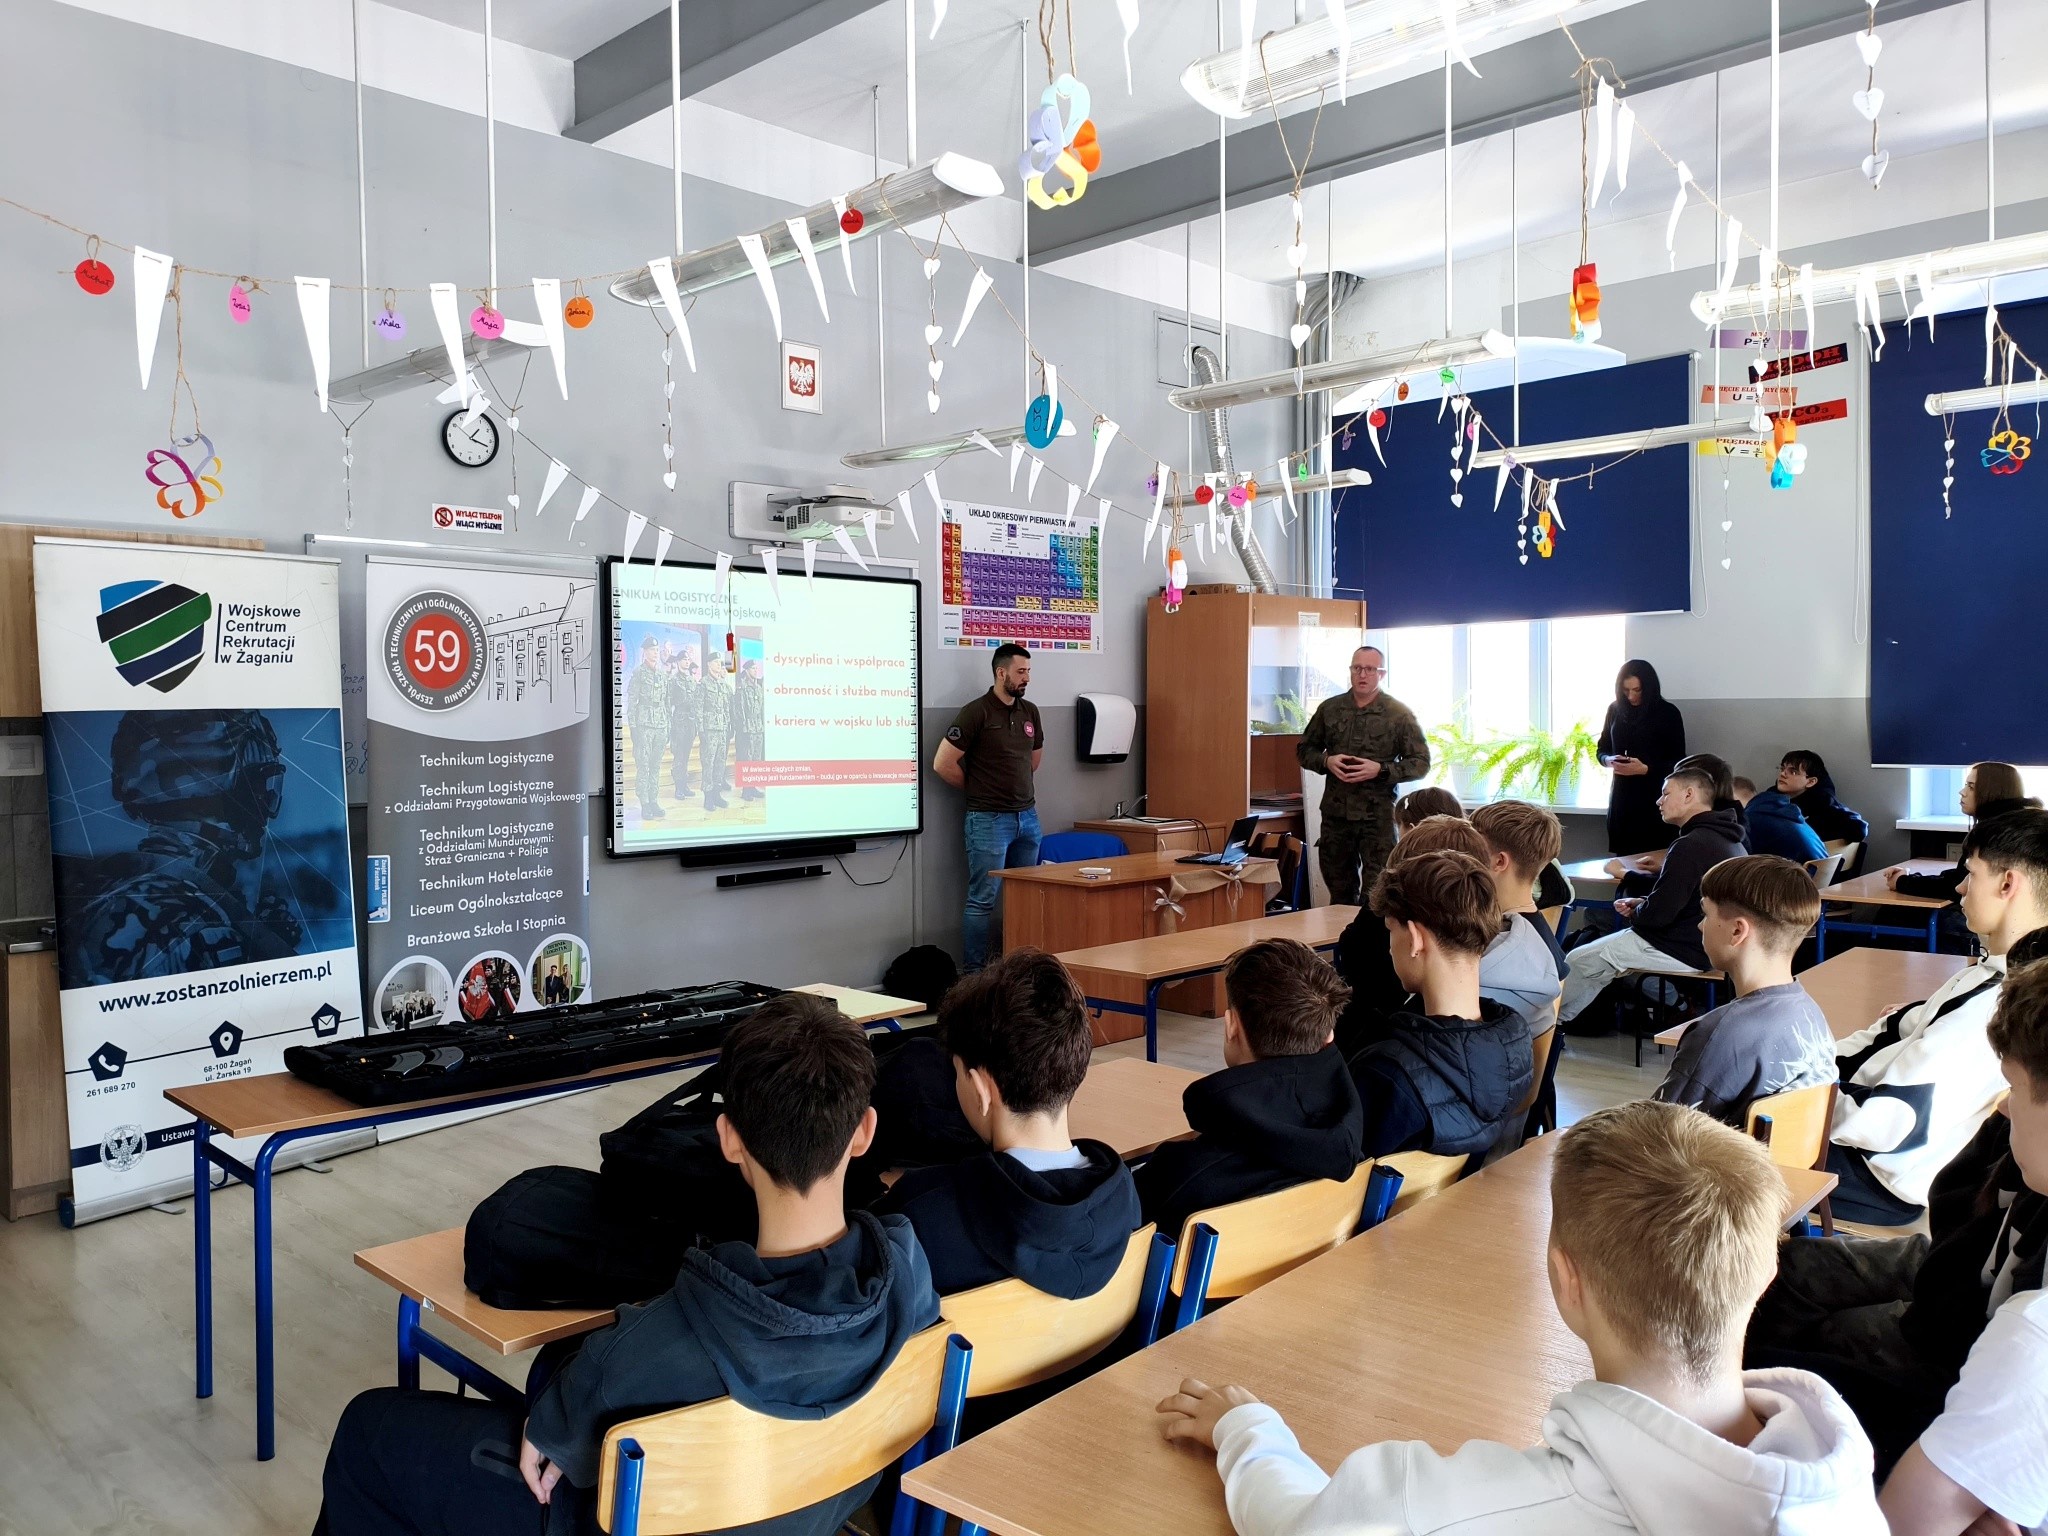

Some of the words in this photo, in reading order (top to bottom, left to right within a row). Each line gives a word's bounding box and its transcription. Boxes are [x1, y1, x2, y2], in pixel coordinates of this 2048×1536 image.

[476, 521, 502, 530] MYŚLENIE
[969, 509, 990, 518] UKŁAD
[992, 513, 1028, 522] OKRESOWY
[1030, 516, 1076, 528] PIERWIASTKW
[621, 589, 661, 600] NIKUM
[664, 592, 738, 604] LOGISTYCZNE
[228, 604, 301, 618] Wojskowe
[655, 605, 661, 613] z
[664, 603, 721, 619] innowacją
[724, 606, 777, 621] wojskową
[226, 620, 286, 633] Centrum
[390, 603, 423, 658] TECHNICZNYCH
[429, 598, 483, 671] OGÓLNOKSZTAŁCĄCYCH
[223, 636, 295, 652] Rekrutacji
[414, 630, 460, 673] 59
[220, 653, 231, 664] w
[237, 650, 293, 666] Żaganiu
[774, 652, 833, 668] dyscyplina
[844, 656, 905, 669] współpraca
[392, 658, 411, 688] SZKÓŁ
[404, 685, 434, 705] ZESPÓŁ
[444, 679, 477, 704] ŻAGANIU
[774, 684, 832, 696] obronność
[842, 685, 877, 696] służba
[774, 715, 816, 726] kariera
[820, 718, 829, 726] w
[834, 716, 872, 729] wojsku
[877, 716, 892, 726] lub
[420, 752, 485, 767] Technikum
[488, 752, 554, 767] Logistyczne
[420, 782, 485, 797] Technikum
[488, 780, 554, 796] Logistyczne
[385, 805, 390, 813] z
[394, 799, 452, 813] Oddziałami
[455, 794, 528, 810] Przygotowania
[530, 792, 586, 806] Wojskowego
[420, 825, 485, 841] Technikum
[488, 821, 554, 838] Logistyczne
[419, 846, 424, 855] z
[427, 840, 485, 854] Oddziałami
[488, 834, 554, 849] Mundurowymi:
[425, 854, 451, 866] Straż
[455, 850, 505, 863] Graniczna
[518, 845, 549, 859] Policja
[419, 873, 485, 891] Technikum
[488, 865, 553, 883] Hotelarskie
[410, 899, 454, 916] Liceum
[458, 888, 563, 913] Ogólnokształcące
[408, 928, 470, 947] Branżowa
[474, 923, 512, 939] Szkoła
[523, 914, 566, 932] Stopnia
[547, 946, 567, 954] LOGISTYK
[99, 960, 332, 1012] www.zostanzolnierzem.pl
[204, 1060, 228, 1073] 68-100
[230, 1058, 252, 1070] Żagań
[206, 1073, 214, 1082] ul.
[216, 1066, 242, 1080] Żarska
[244, 1066, 252, 1074] 19
[86, 1088, 102, 1098] 261
[104, 1085, 119, 1094] 689
[120, 1082, 136, 1091] 270
[161, 1128, 195, 1142] Ustawa
